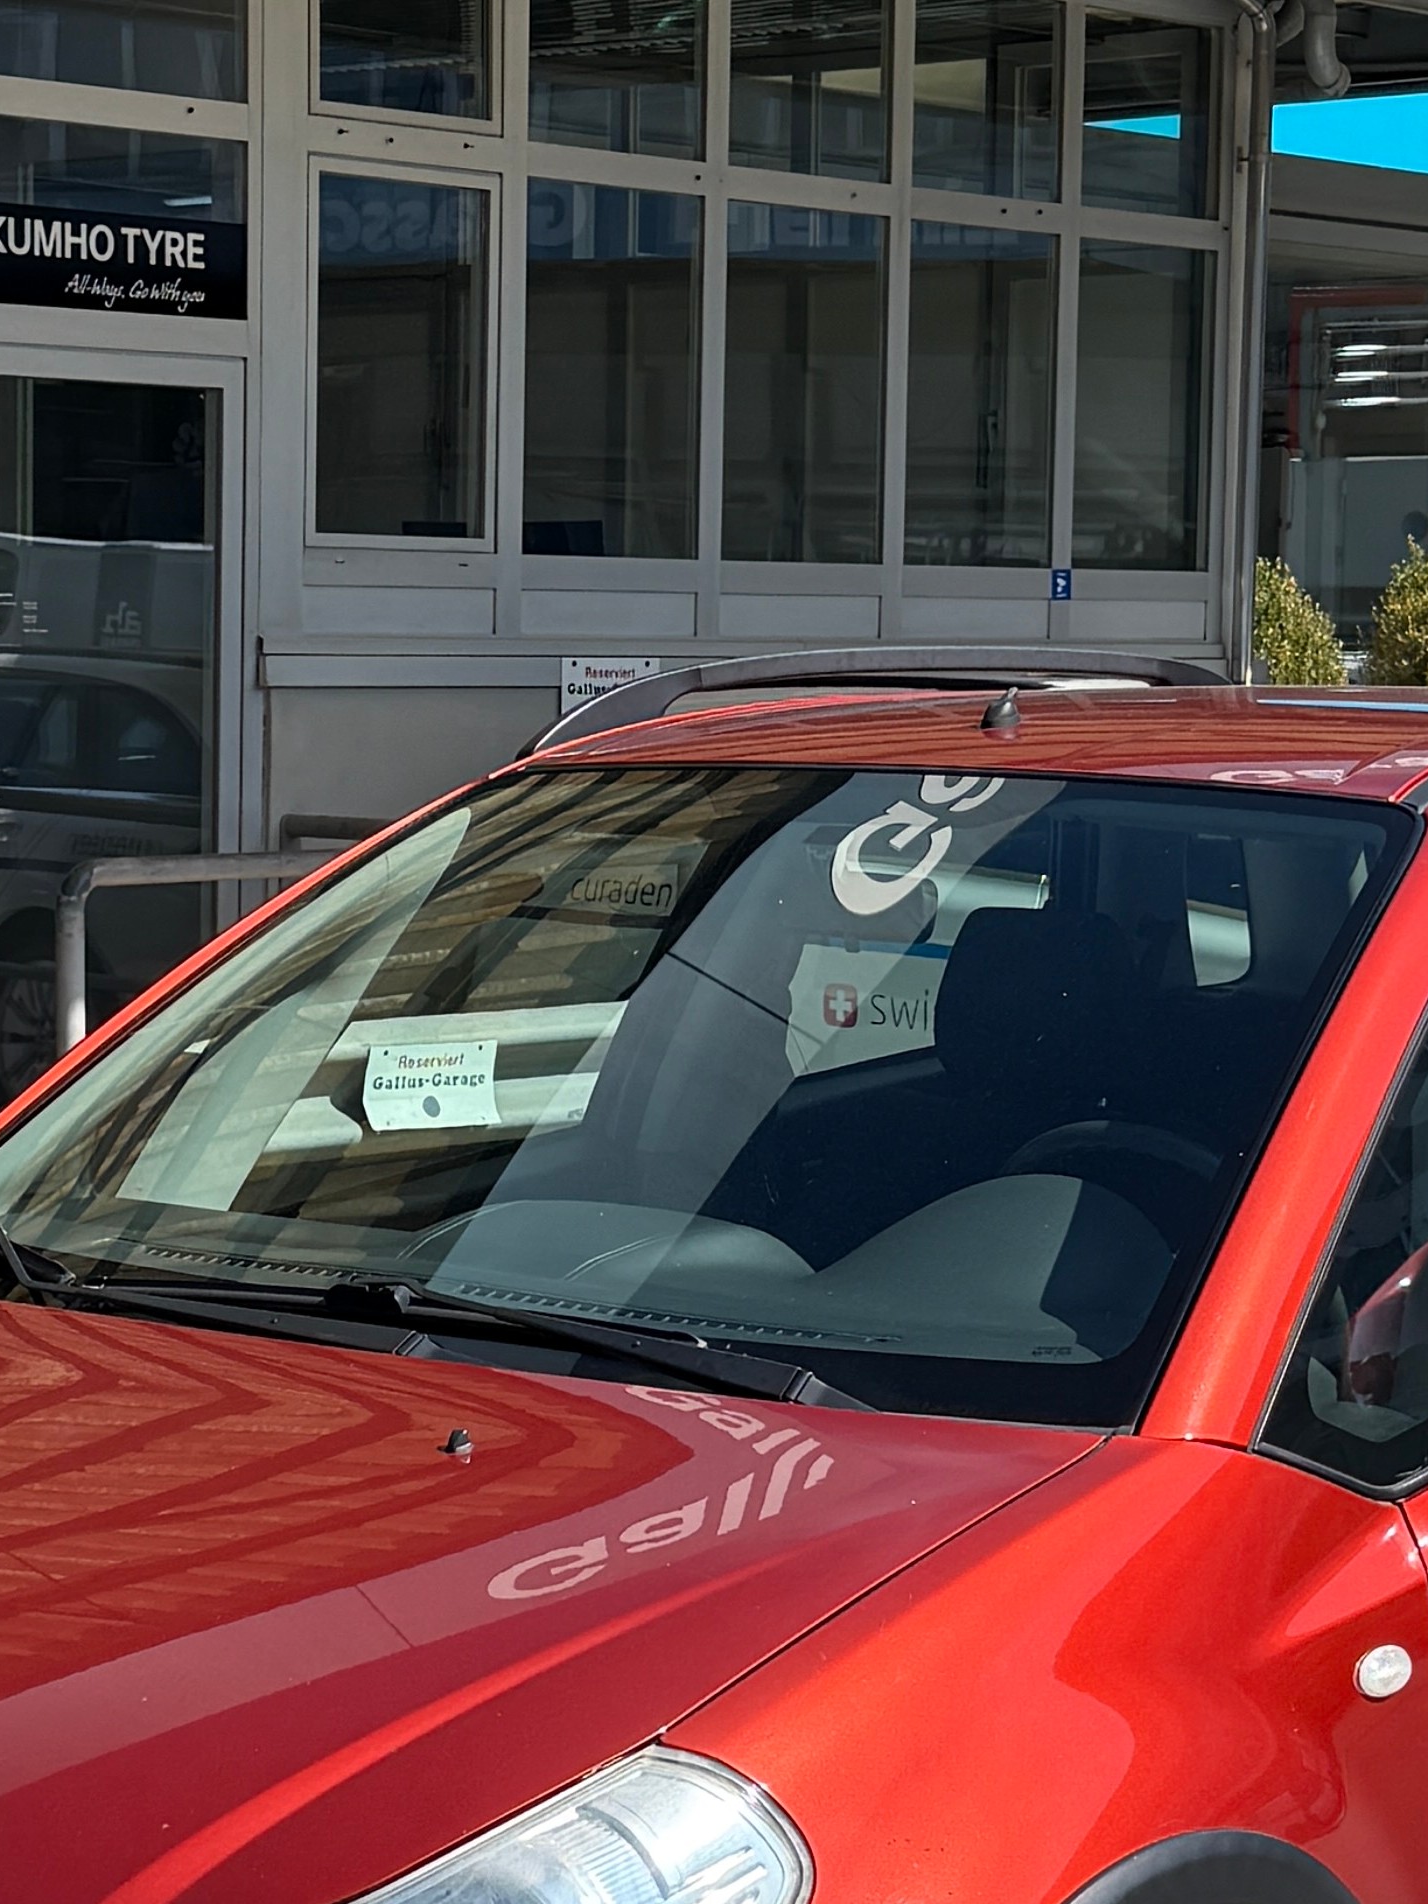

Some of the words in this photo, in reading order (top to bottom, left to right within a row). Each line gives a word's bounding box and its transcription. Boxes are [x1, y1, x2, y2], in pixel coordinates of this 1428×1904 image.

[120, 227, 205, 269] TYRE
[585, 667, 635, 679] Reserviert
[571, 874, 672, 907] curaden
[373, 1073, 486, 1090] Gallus-Garage
